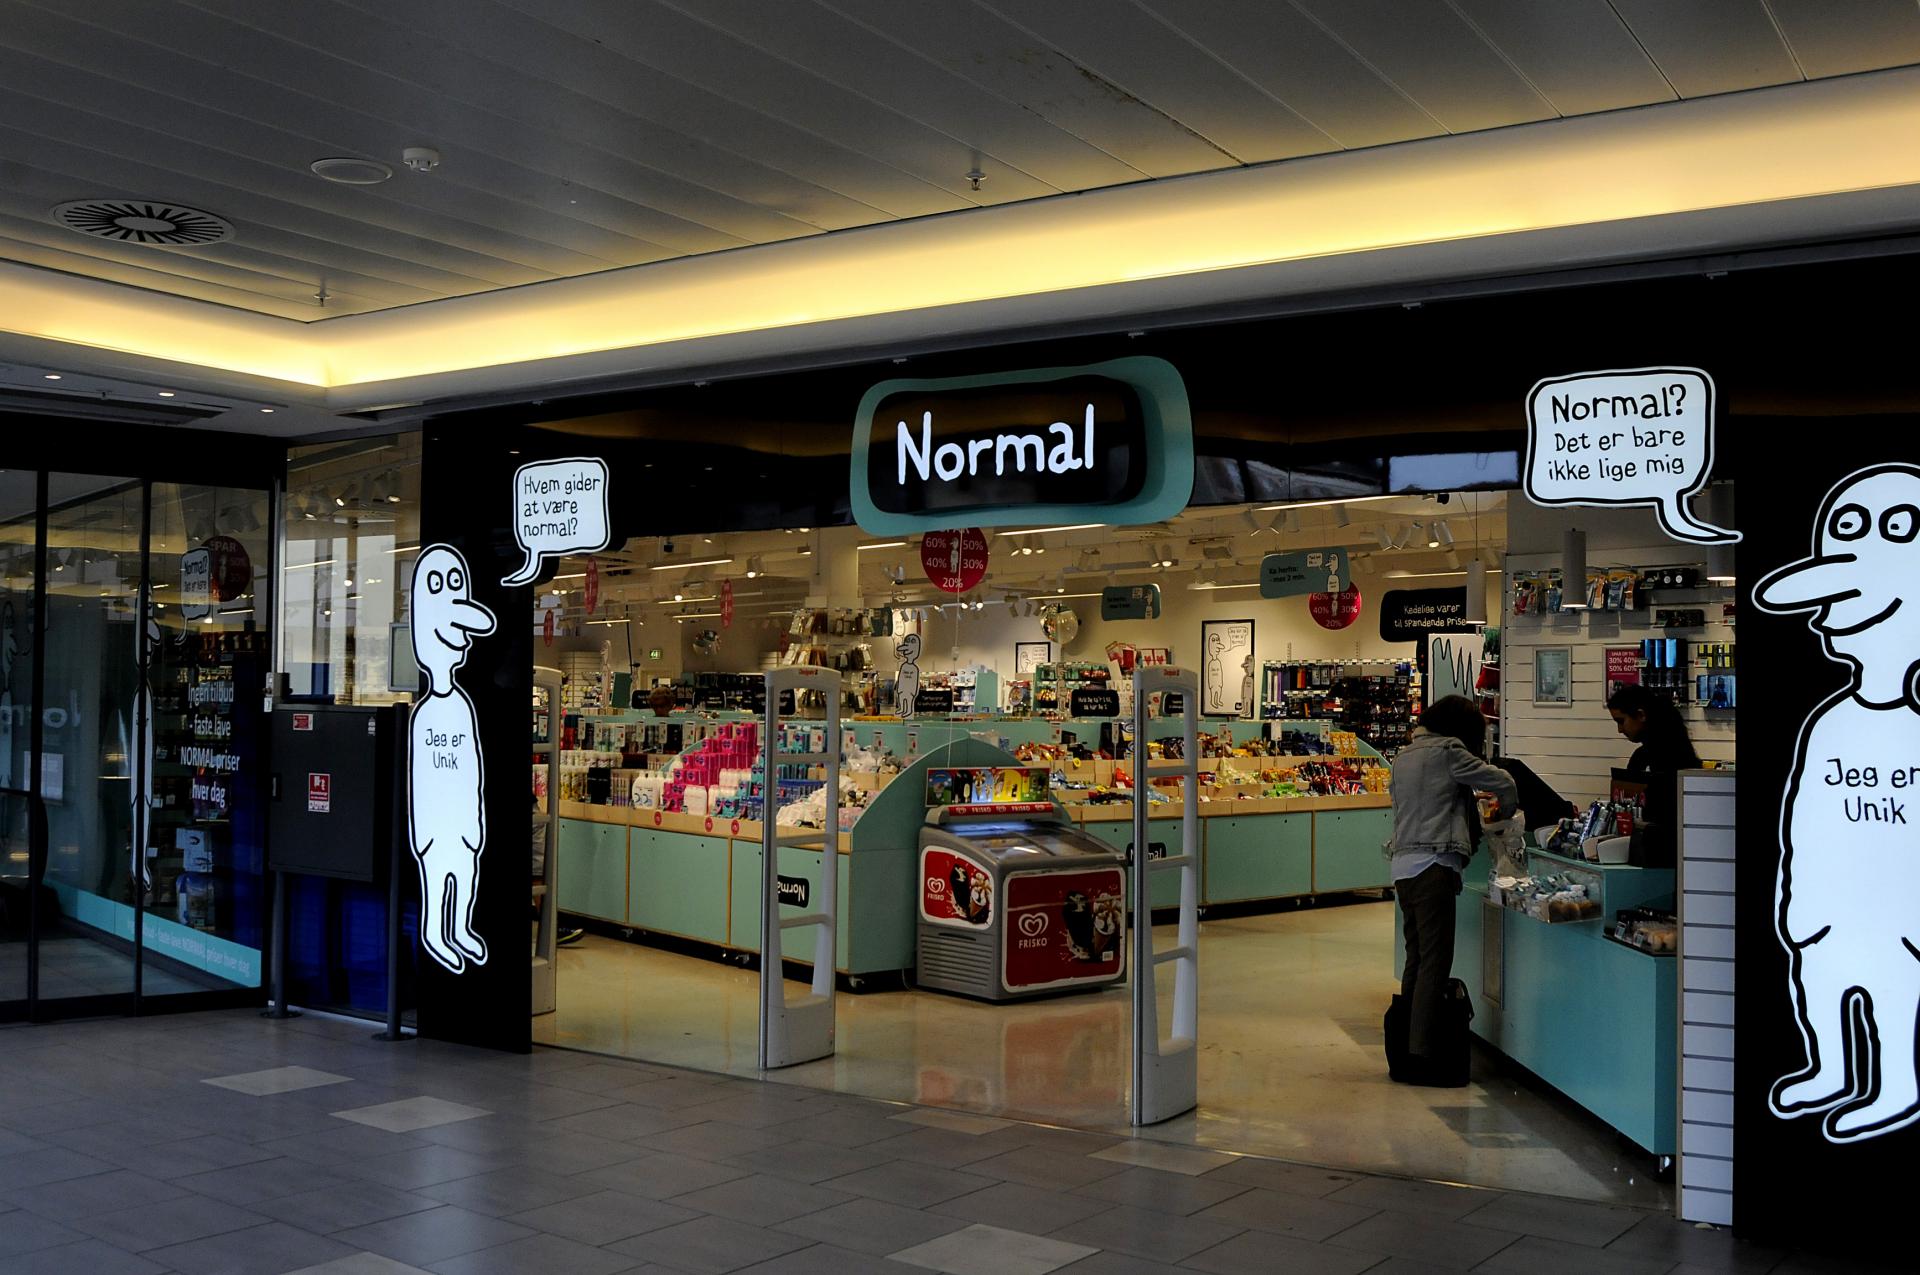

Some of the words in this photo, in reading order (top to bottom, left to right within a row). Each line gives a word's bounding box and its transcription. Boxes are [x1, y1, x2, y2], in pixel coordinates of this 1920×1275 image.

[1551, 384, 1687, 424] Normal?
[897, 403, 1094, 485] Normal
[1555, 433, 1591, 452] Det
[1598, 432, 1625, 451] er
[1632, 426, 1685, 447] bare
[1548, 460, 1591, 481] ikke
[1599, 457, 1637, 481] lige
[1646, 454, 1685, 474] mig
[524, 475, 560, 494] Hvem
[564, 472, 601, 494] gider
[523, 500, 539, 517] at
[542, 500, 579, 515] være
[523, 517, 578, 537] normal?
[925, 537, 947, 548] 60%
[963, 540, 984, 550] 50%
[926, 557, 948, 568] 40%
[963, 559, 984, 569] 30%
[943, 577, 964, 588] 20%
[1312, 592, 1329, 600] 60%
[1341, 592, 1358, 600] 50%
[1313, 606, 1329, 614] 40%
[1341, 605, 1358, 613] 30%
[1437, 604, 1460, 613] varer
[1325, 619, 1342, 627] 20%
[1394, 619, 1403, 628] til
[1446, 616, 1467, 627] prise
[188, 683, 209, 706] Ingen
[211, 681, 235, 703] tilbud
[194, 714, 213, 735] faste
[214, 715, 231, 738] lave
[425, 728, 448, 747] Jeg
[451, 733, 466, 748] er
[180, 746, 214, 768] NORMAL
[215, 749, 240, 774] priser
[433, 751, 459, 770] Unik
[1824, 758, 1879, 788] Jeg
[1891, 766, 1920, 788] er
[192, 779, 209, 800] hver
[210, 781, 226, 808] dag
[1844, 795, 1907, 825] Unik
[927, 893, 945, 901] FRISKO
[1018, 937, 1048, 950] FRISKO
